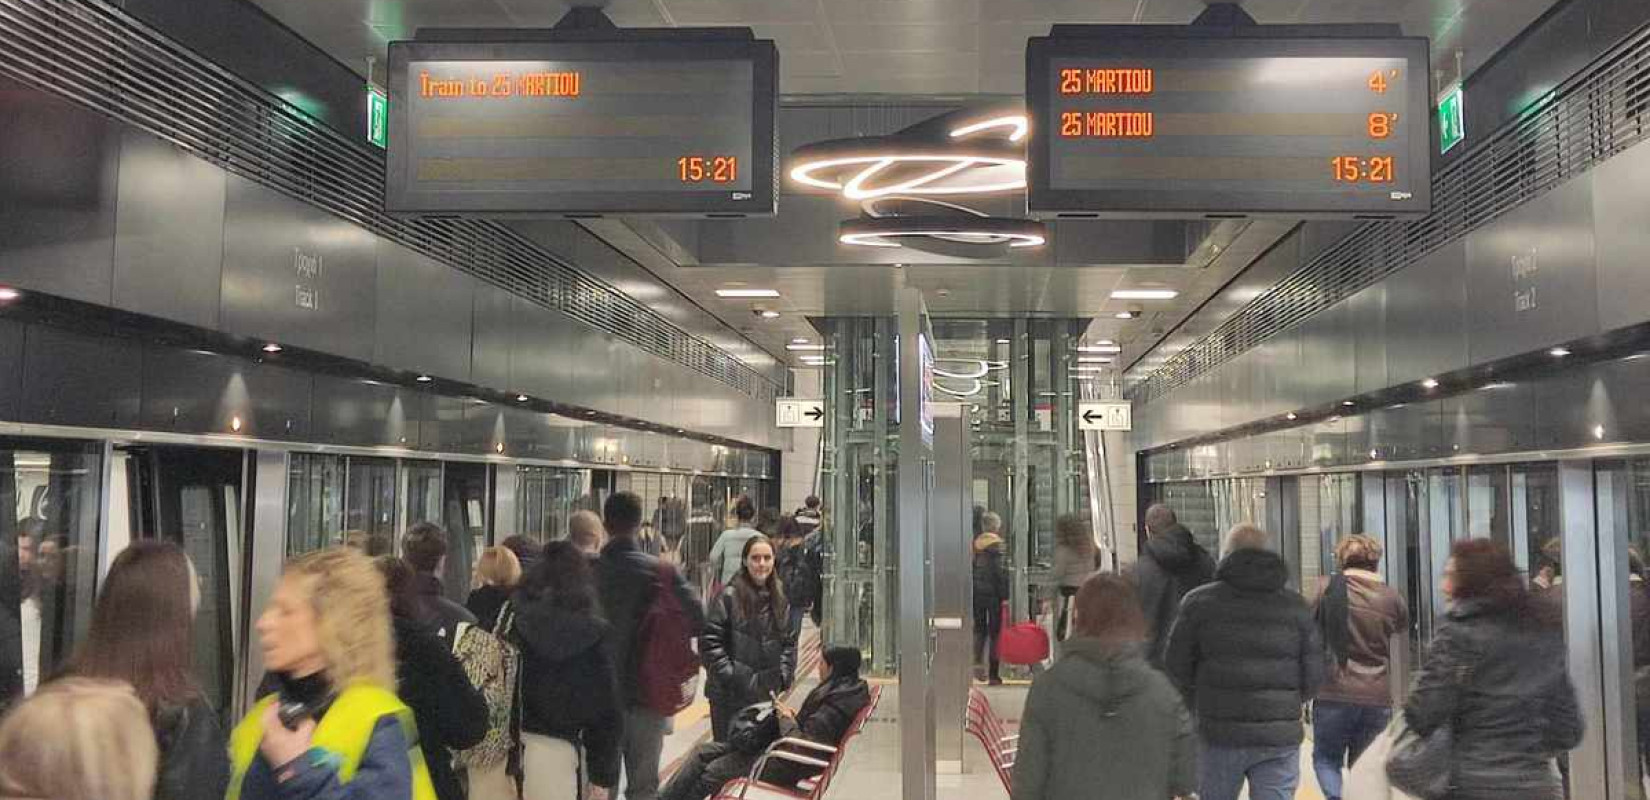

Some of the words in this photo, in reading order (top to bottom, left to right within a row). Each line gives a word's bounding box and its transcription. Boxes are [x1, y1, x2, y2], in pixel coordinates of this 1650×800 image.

[420, 70, 463, 97] Train
[470, 74, 488, 97] to
[492, 73, 510, 97] 25
[514, 72, 580, 97] MARTIOU
[1061, 68, 1082, 93] 25
[1086, 68, 1153, 93] MARTIOU
[1061, 112, 1082, 137] 25
[1086, 112, 1153, 137] MARTIOU
[677, 157, 737, 182] 15:21
[1331, 156, 1394, 182] 15:21
